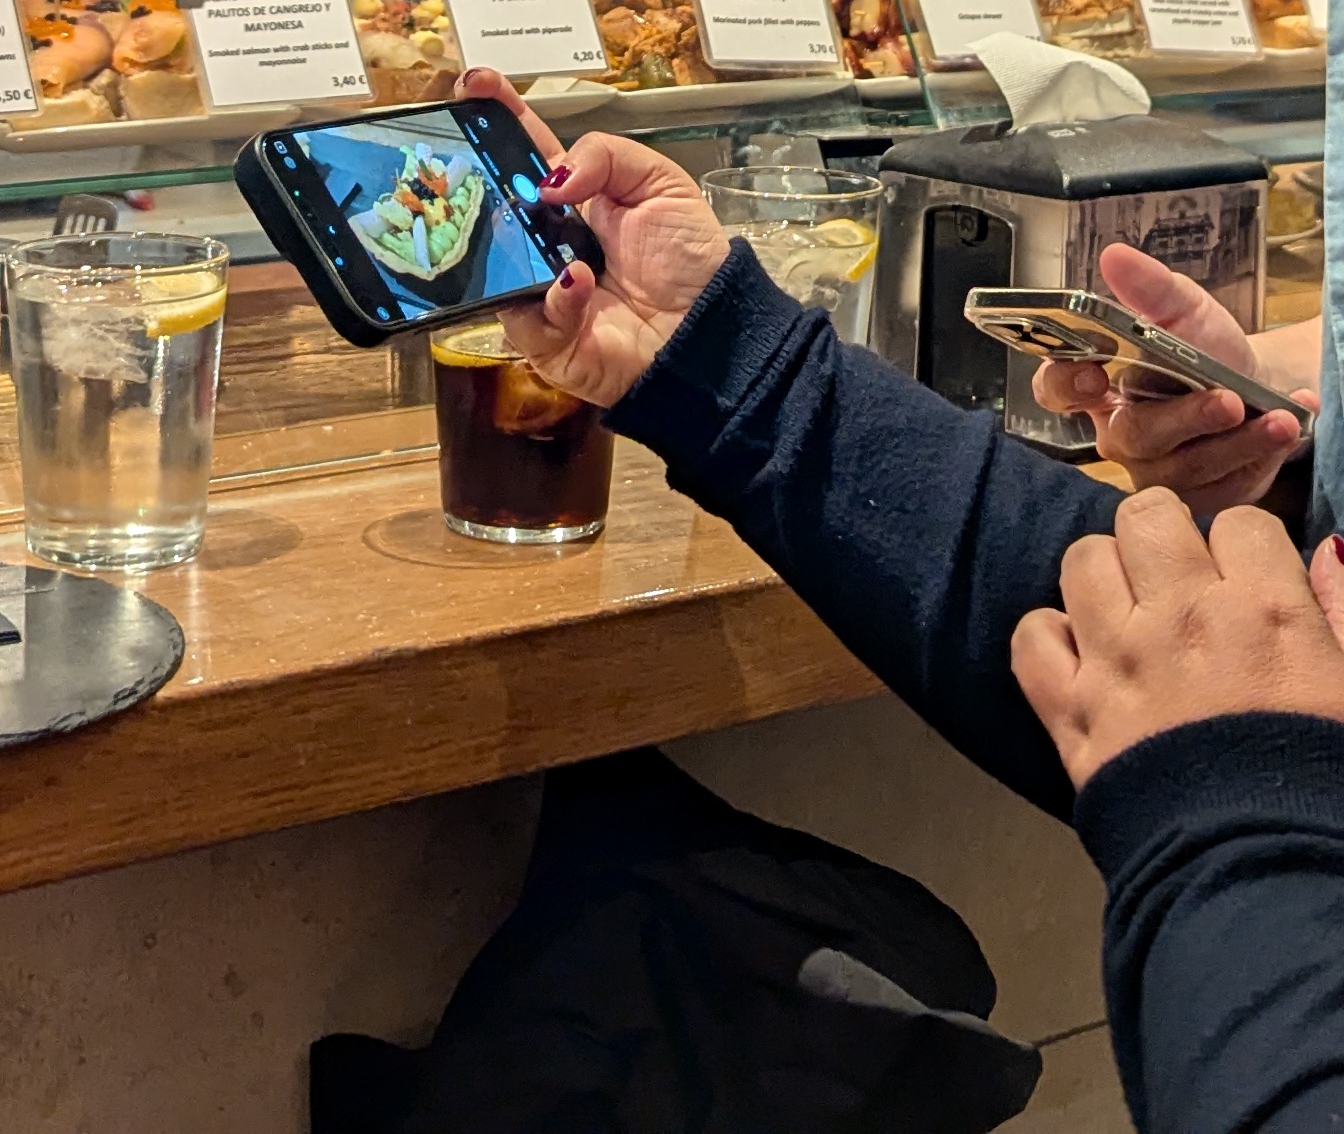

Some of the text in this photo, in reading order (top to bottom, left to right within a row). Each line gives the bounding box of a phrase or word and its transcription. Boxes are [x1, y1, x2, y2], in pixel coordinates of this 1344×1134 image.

[208, 3, 331, 18] PALITOS DE CANGREJO Y
[244, 20, 304, 32] MAYONESA
[208, 49, 240, 57] Smoked
[242, 47, 271, 56] salmon
[273, 45, 290, 53] with
[293, 44, 309, 52] crab
[312, 42, 332, 51] sticks
[332, 75, 366, 87] 3,40 €
[24, 89, 33, 99] €
